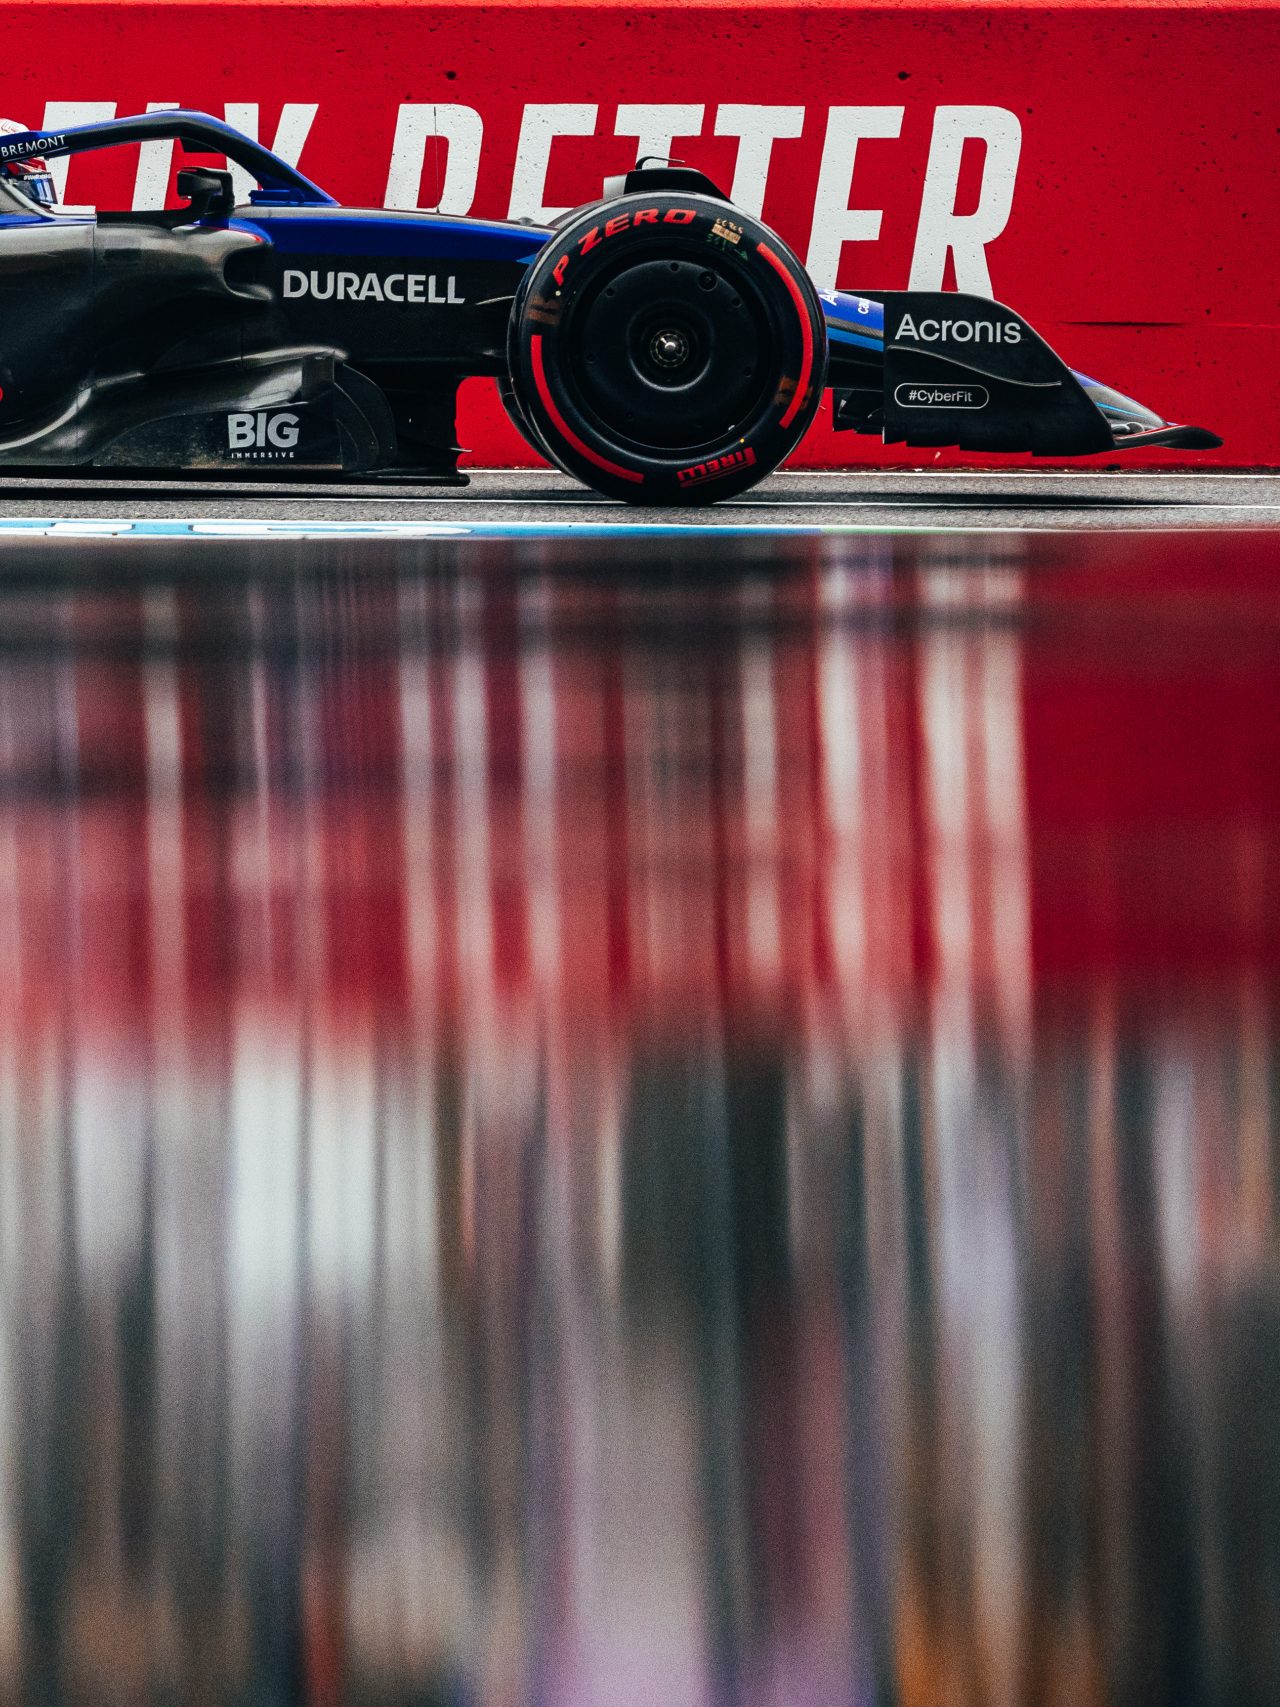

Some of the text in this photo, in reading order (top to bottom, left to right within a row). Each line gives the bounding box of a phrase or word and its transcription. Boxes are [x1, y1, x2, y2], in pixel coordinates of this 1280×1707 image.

[1, 135, 66, 157] BREMONT
[552, 254, 569, 287] P
[577, 208, 697, 256] ZERO
[283, 270, 465, 304] DURACELL
[894, 313, 1022, 344] Acronis
[908, 390, 973, 403] #CyberFit
[227, 412, 300, 449] BIG
[231, 451, 295, 459] IMMERSIVE
[676, 447, 757, 488] PIRELLI
